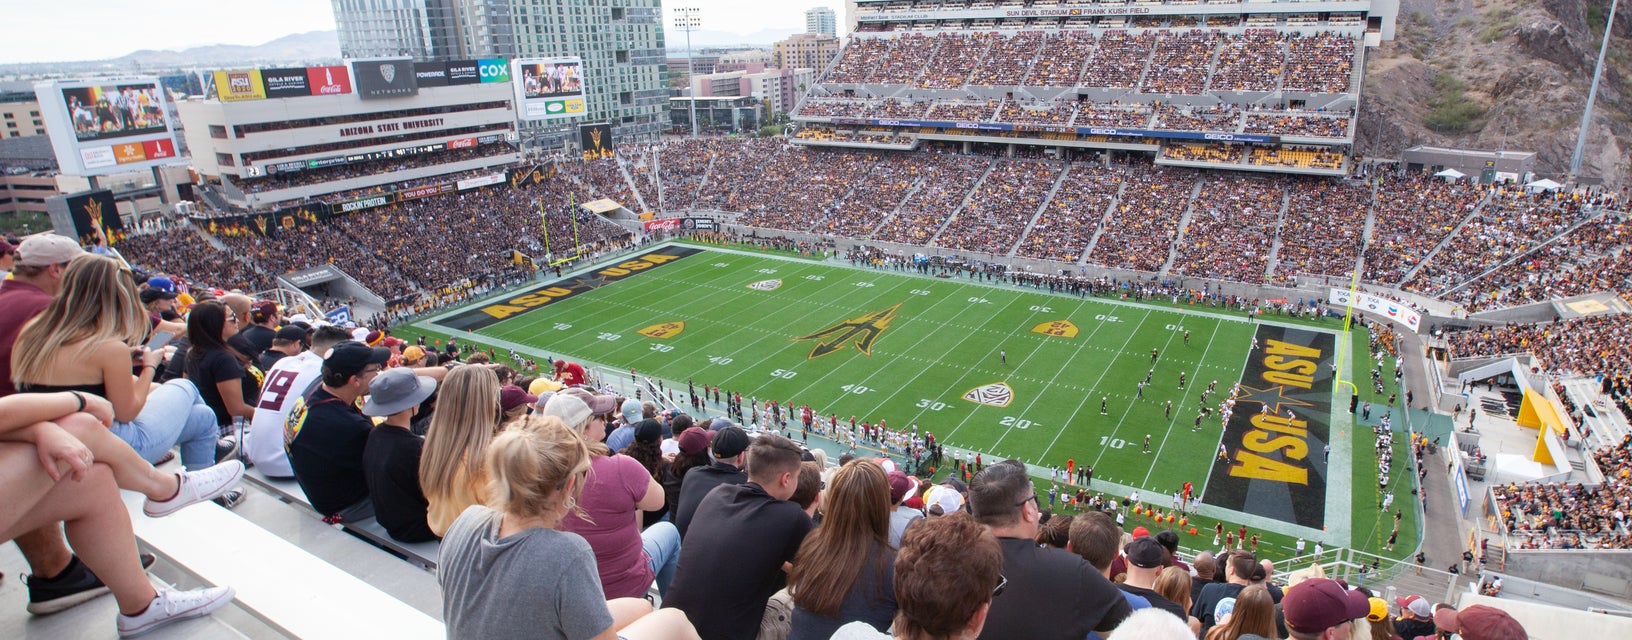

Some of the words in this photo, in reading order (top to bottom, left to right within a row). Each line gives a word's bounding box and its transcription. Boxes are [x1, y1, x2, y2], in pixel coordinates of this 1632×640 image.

[480, 64, 508, 78] COX
[231, 77, 249, 87] ASU
[371, 88, 412, 96] NETWORKS
[340, 124, 374, 137] ARIZONA
[377, 122, 400, 133] STATE
[402, 118, 444, 130] UNIVERSITY
[1204, 133, 1234, 141] GEICO
[403, 191, 416, 199] YOU
[425, 187, 438, 195] YOU
[364, 196, 387, 208] PROTEIN
[481, 286, 572, 319] ASU
[600, 253, 681, 278] USA
[1262, 338, 1322, 389] ASU
[769, 368, 798, 379] 50
[841, 384, 868, 395] 40
[915, 398, 946, 411] 30
[999, 416, 1032, 430] 20
[1099, 436, 1126, 449] 10
[1229, 414, 1309, 486] USA
